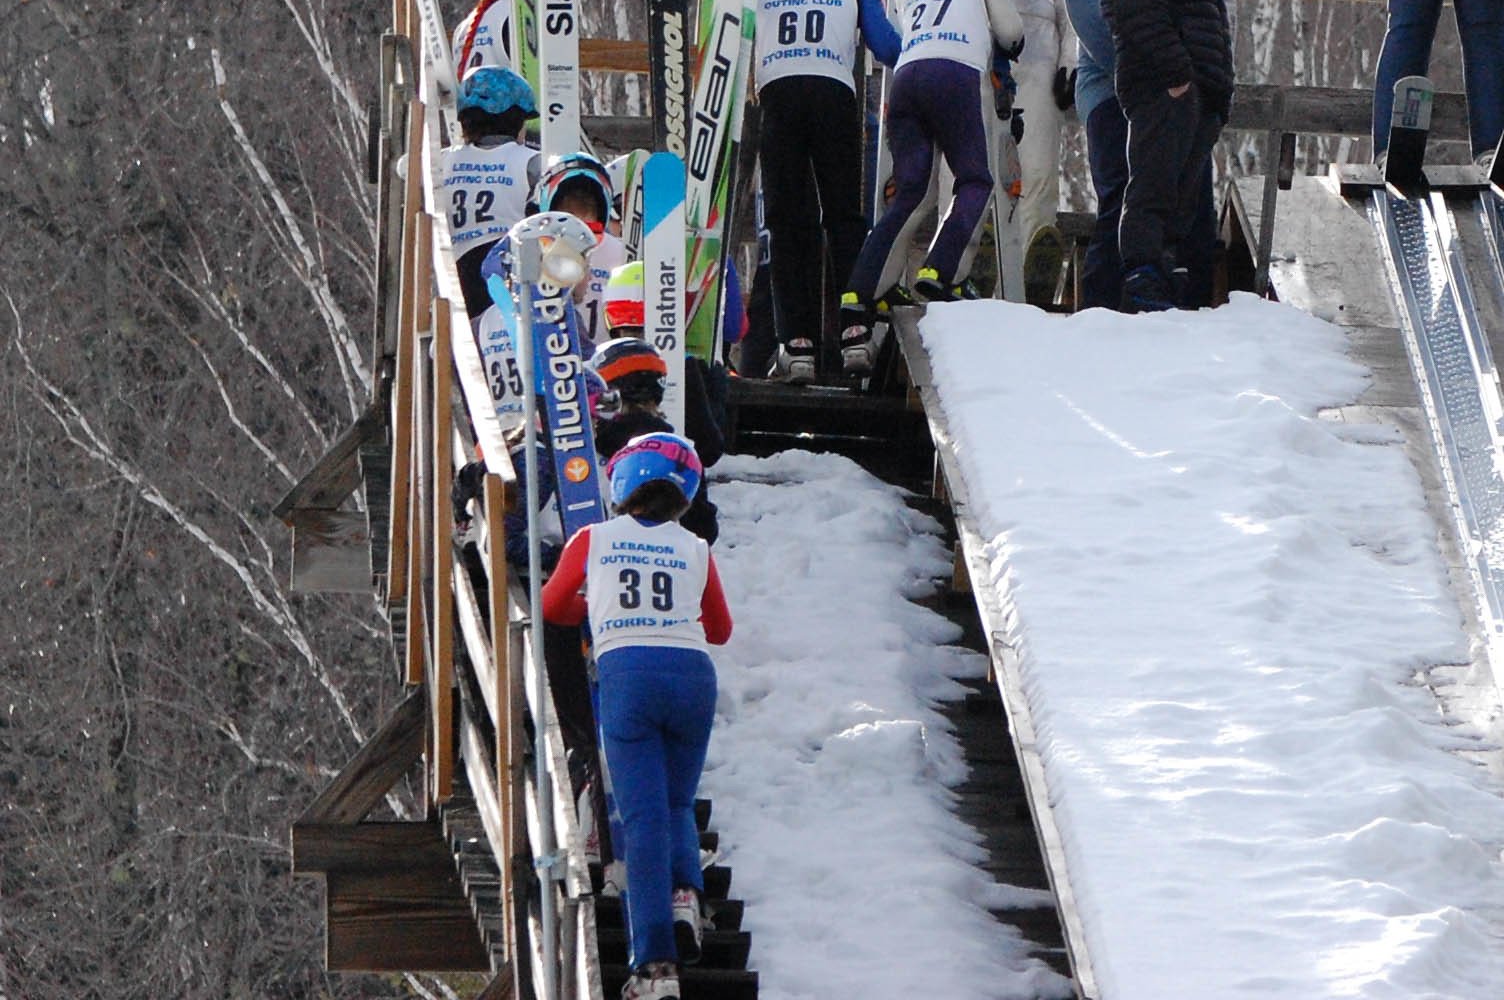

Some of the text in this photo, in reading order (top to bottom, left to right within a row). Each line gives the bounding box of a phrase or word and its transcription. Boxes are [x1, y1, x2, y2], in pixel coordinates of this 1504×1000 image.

[764, 0, 808, 10] OUTING
[778, 9, 826, 45] 60
[938, 32, 970, 44] HILL
[762, 47, 811, 67] STORRS
[664, 11, 686, 160] OSSIGNOL
[691, 12, 740, 182] elan
[452, 163, 506, 172] LEBANON
[485, 176, 514, 186] CLUB
[452, 189, 495, 229] 32
[655, 261, 676, 352] Slatnar
[491, 358, 524, 401] 35
[534, 278, 585, 452] fluege.de
[600, 555, 687, 570] OUTING CLUB
[612, 541, 675, 554] LEBANON
[619, 568, 674, 612] 39
